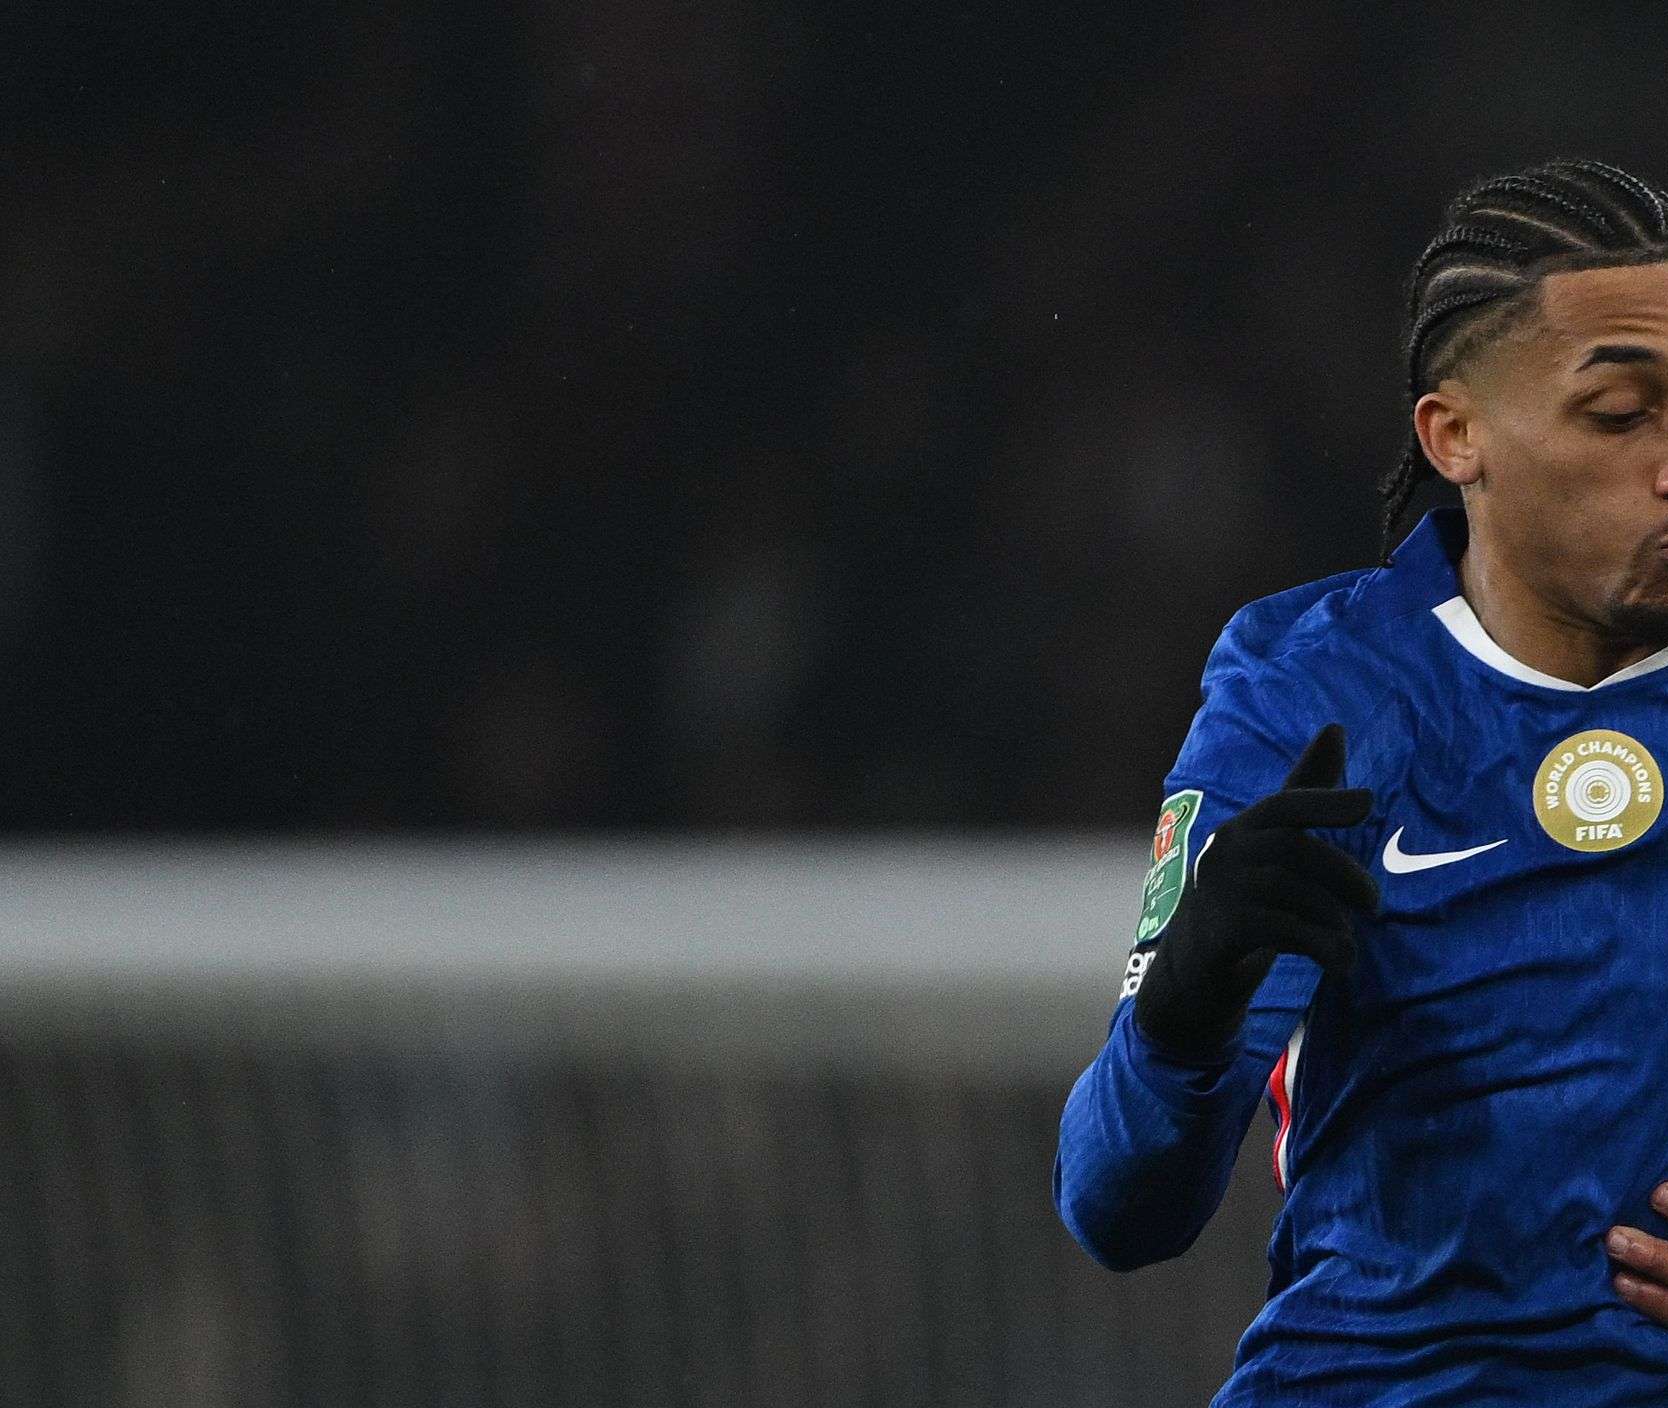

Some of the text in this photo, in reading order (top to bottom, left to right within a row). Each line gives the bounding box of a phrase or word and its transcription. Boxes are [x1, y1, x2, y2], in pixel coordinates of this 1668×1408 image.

[1546, 741, 1652, 810] WORLD CHAMPIONS
[1575, 823, 1623, 841] FIFA
